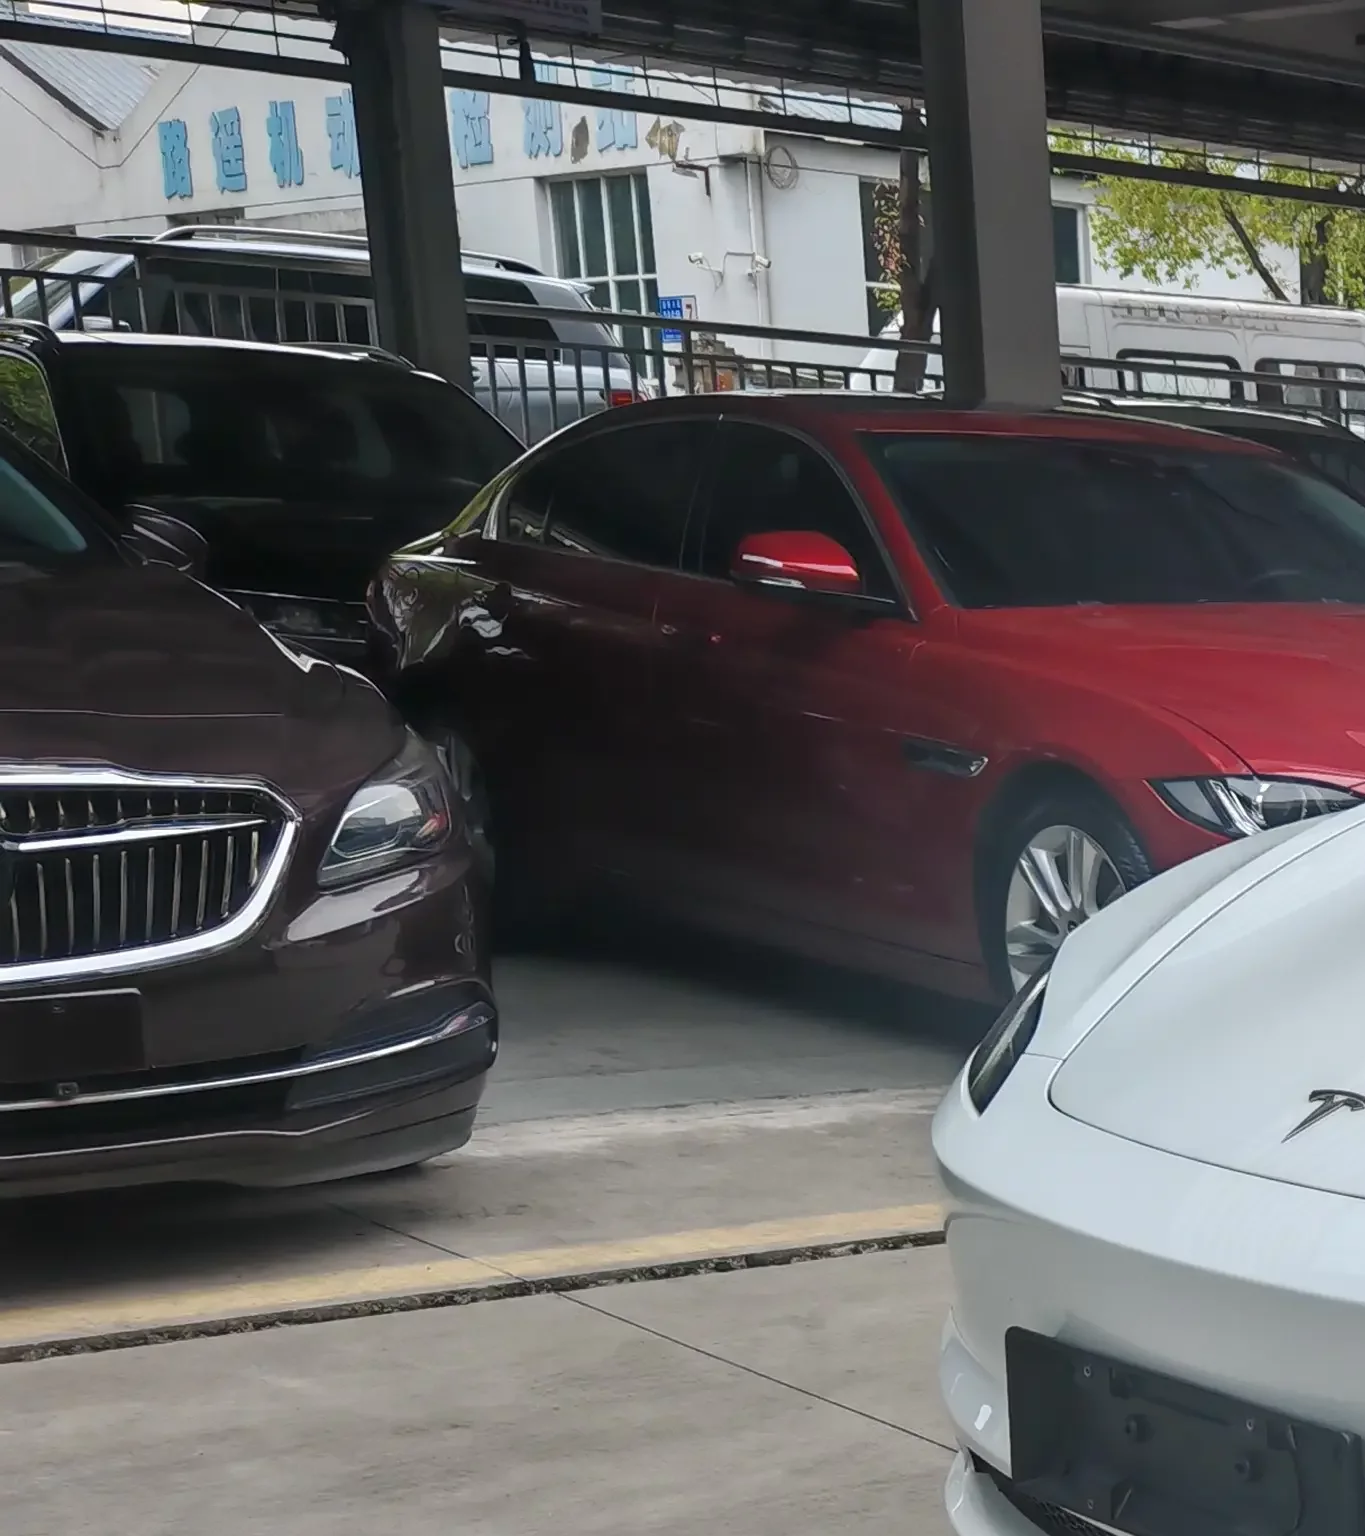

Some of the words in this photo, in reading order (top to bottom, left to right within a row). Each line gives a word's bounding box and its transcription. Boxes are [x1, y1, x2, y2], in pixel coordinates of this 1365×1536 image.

[158, 60, 637, 199] 路遥机动检测站
